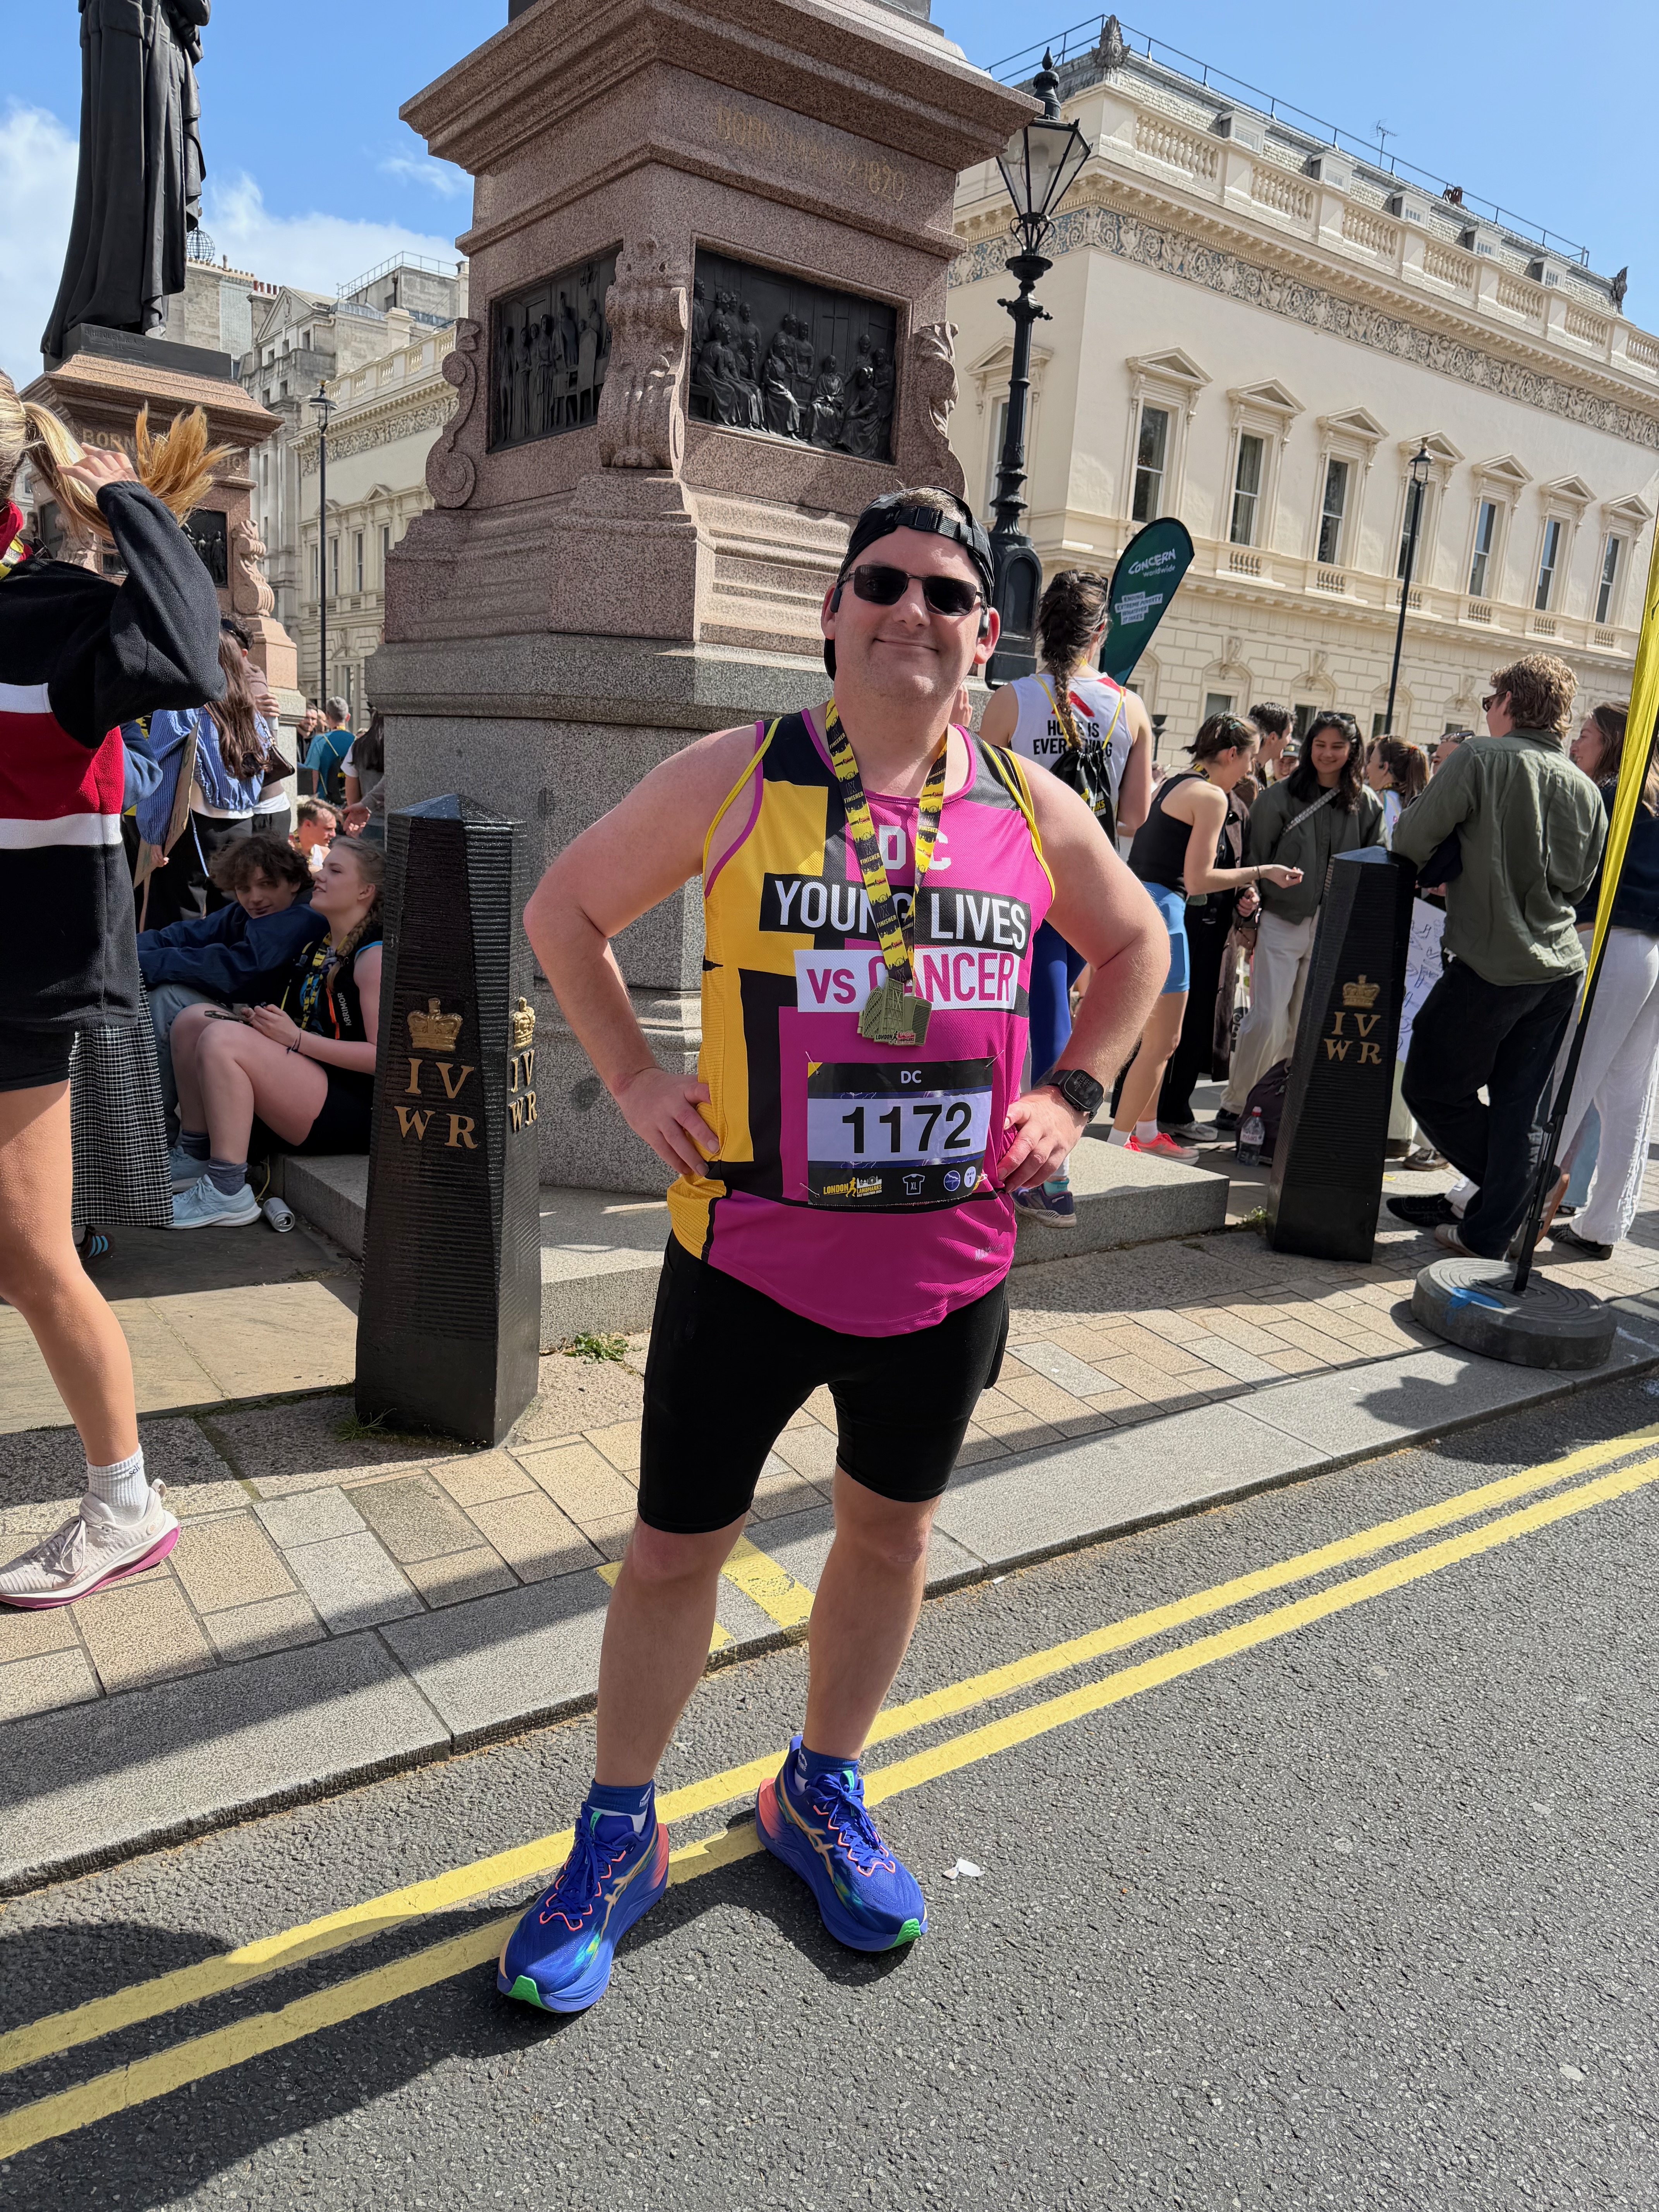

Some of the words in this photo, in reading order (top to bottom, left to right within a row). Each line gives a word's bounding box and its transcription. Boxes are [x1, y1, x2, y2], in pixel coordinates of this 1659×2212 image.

[82, 428, 135, 452] BORN
[1128, 548, 1176, 575] CONCERN
[1143, 564, 1175, 577] worldwide
[1088, 722, 1099, 738] IS
[830, 732, 846, 750] FINISHER
[1033, 738, 1113, 758] EVERING
[844, 791, 864, 804] FINISHER
[860, 853, 881, 865] FINISHER
[876, 914, 897, 929] FINISHER
[931, 893, 1026, 951] LIVES
[807, 969, 855, 1005] VS
[901, 1070, 922, 1084] DC
[842, 1101, 972, 1154] 1172
[823, 1183, 849, 1195] LONDON
[857, 1184, 882, 1194] LANDMARKS
[910, 1182, 917, 1190] XL
